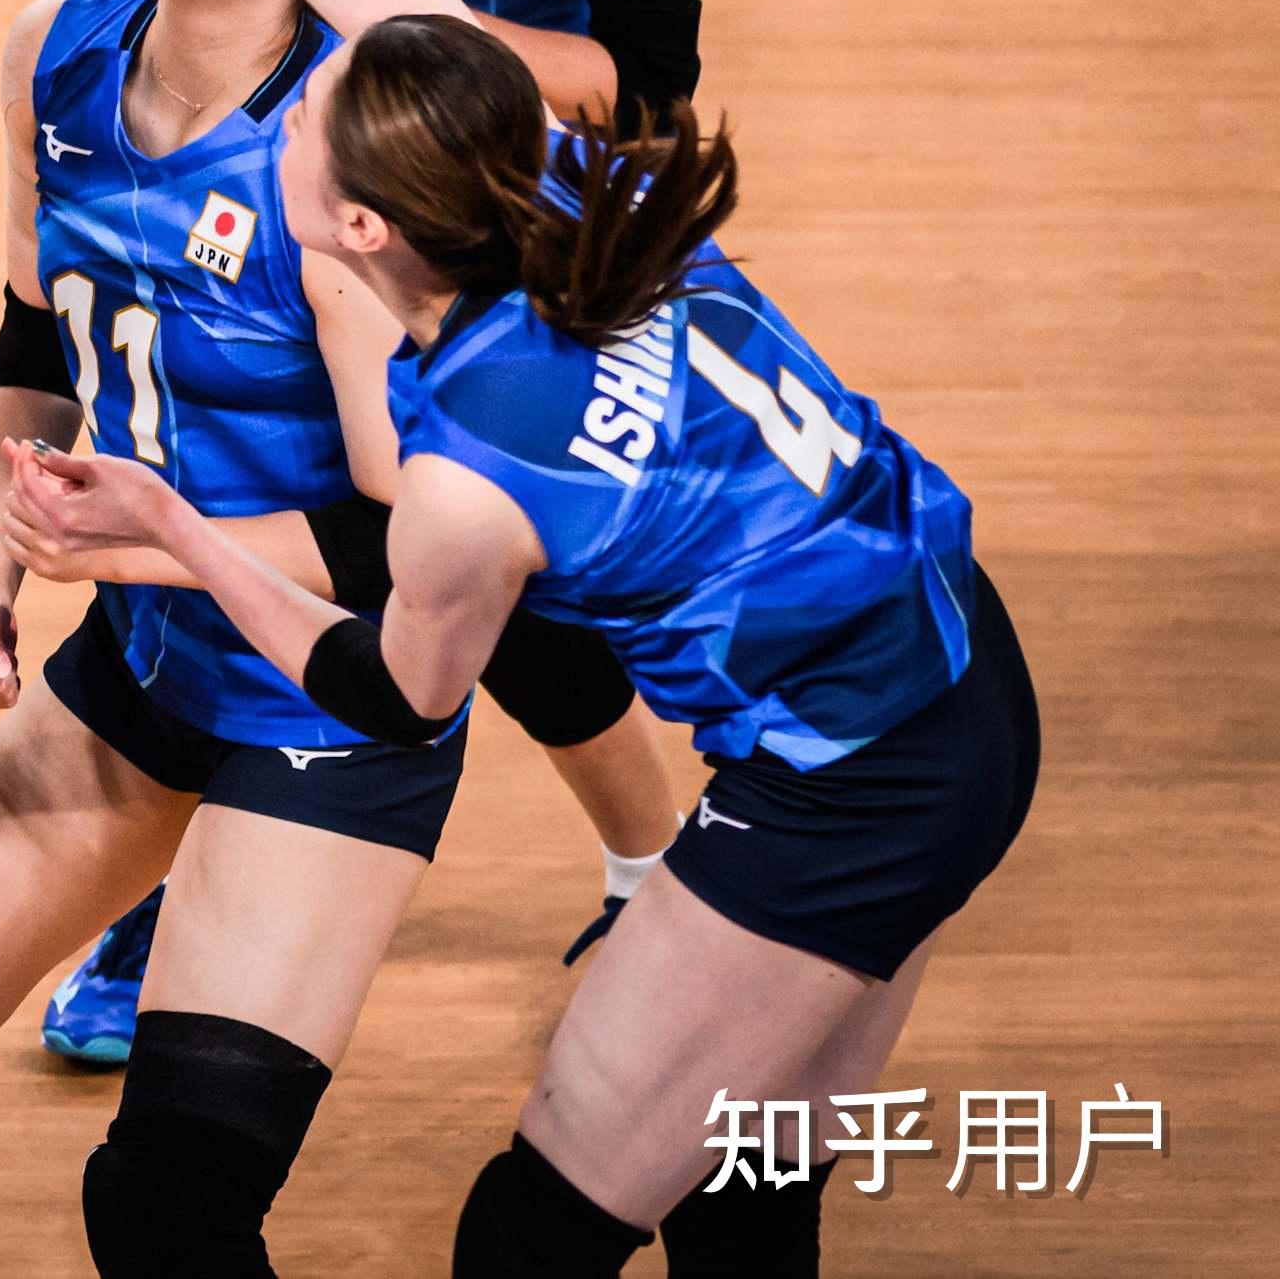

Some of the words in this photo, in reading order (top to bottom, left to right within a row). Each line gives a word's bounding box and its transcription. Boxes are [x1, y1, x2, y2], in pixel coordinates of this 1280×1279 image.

[194, 243, 231, 274] JPN
[52, 269, 167, 467] 11
[567, 305, 674, 488] ISHI
[686, 322, 863, 498] 4
